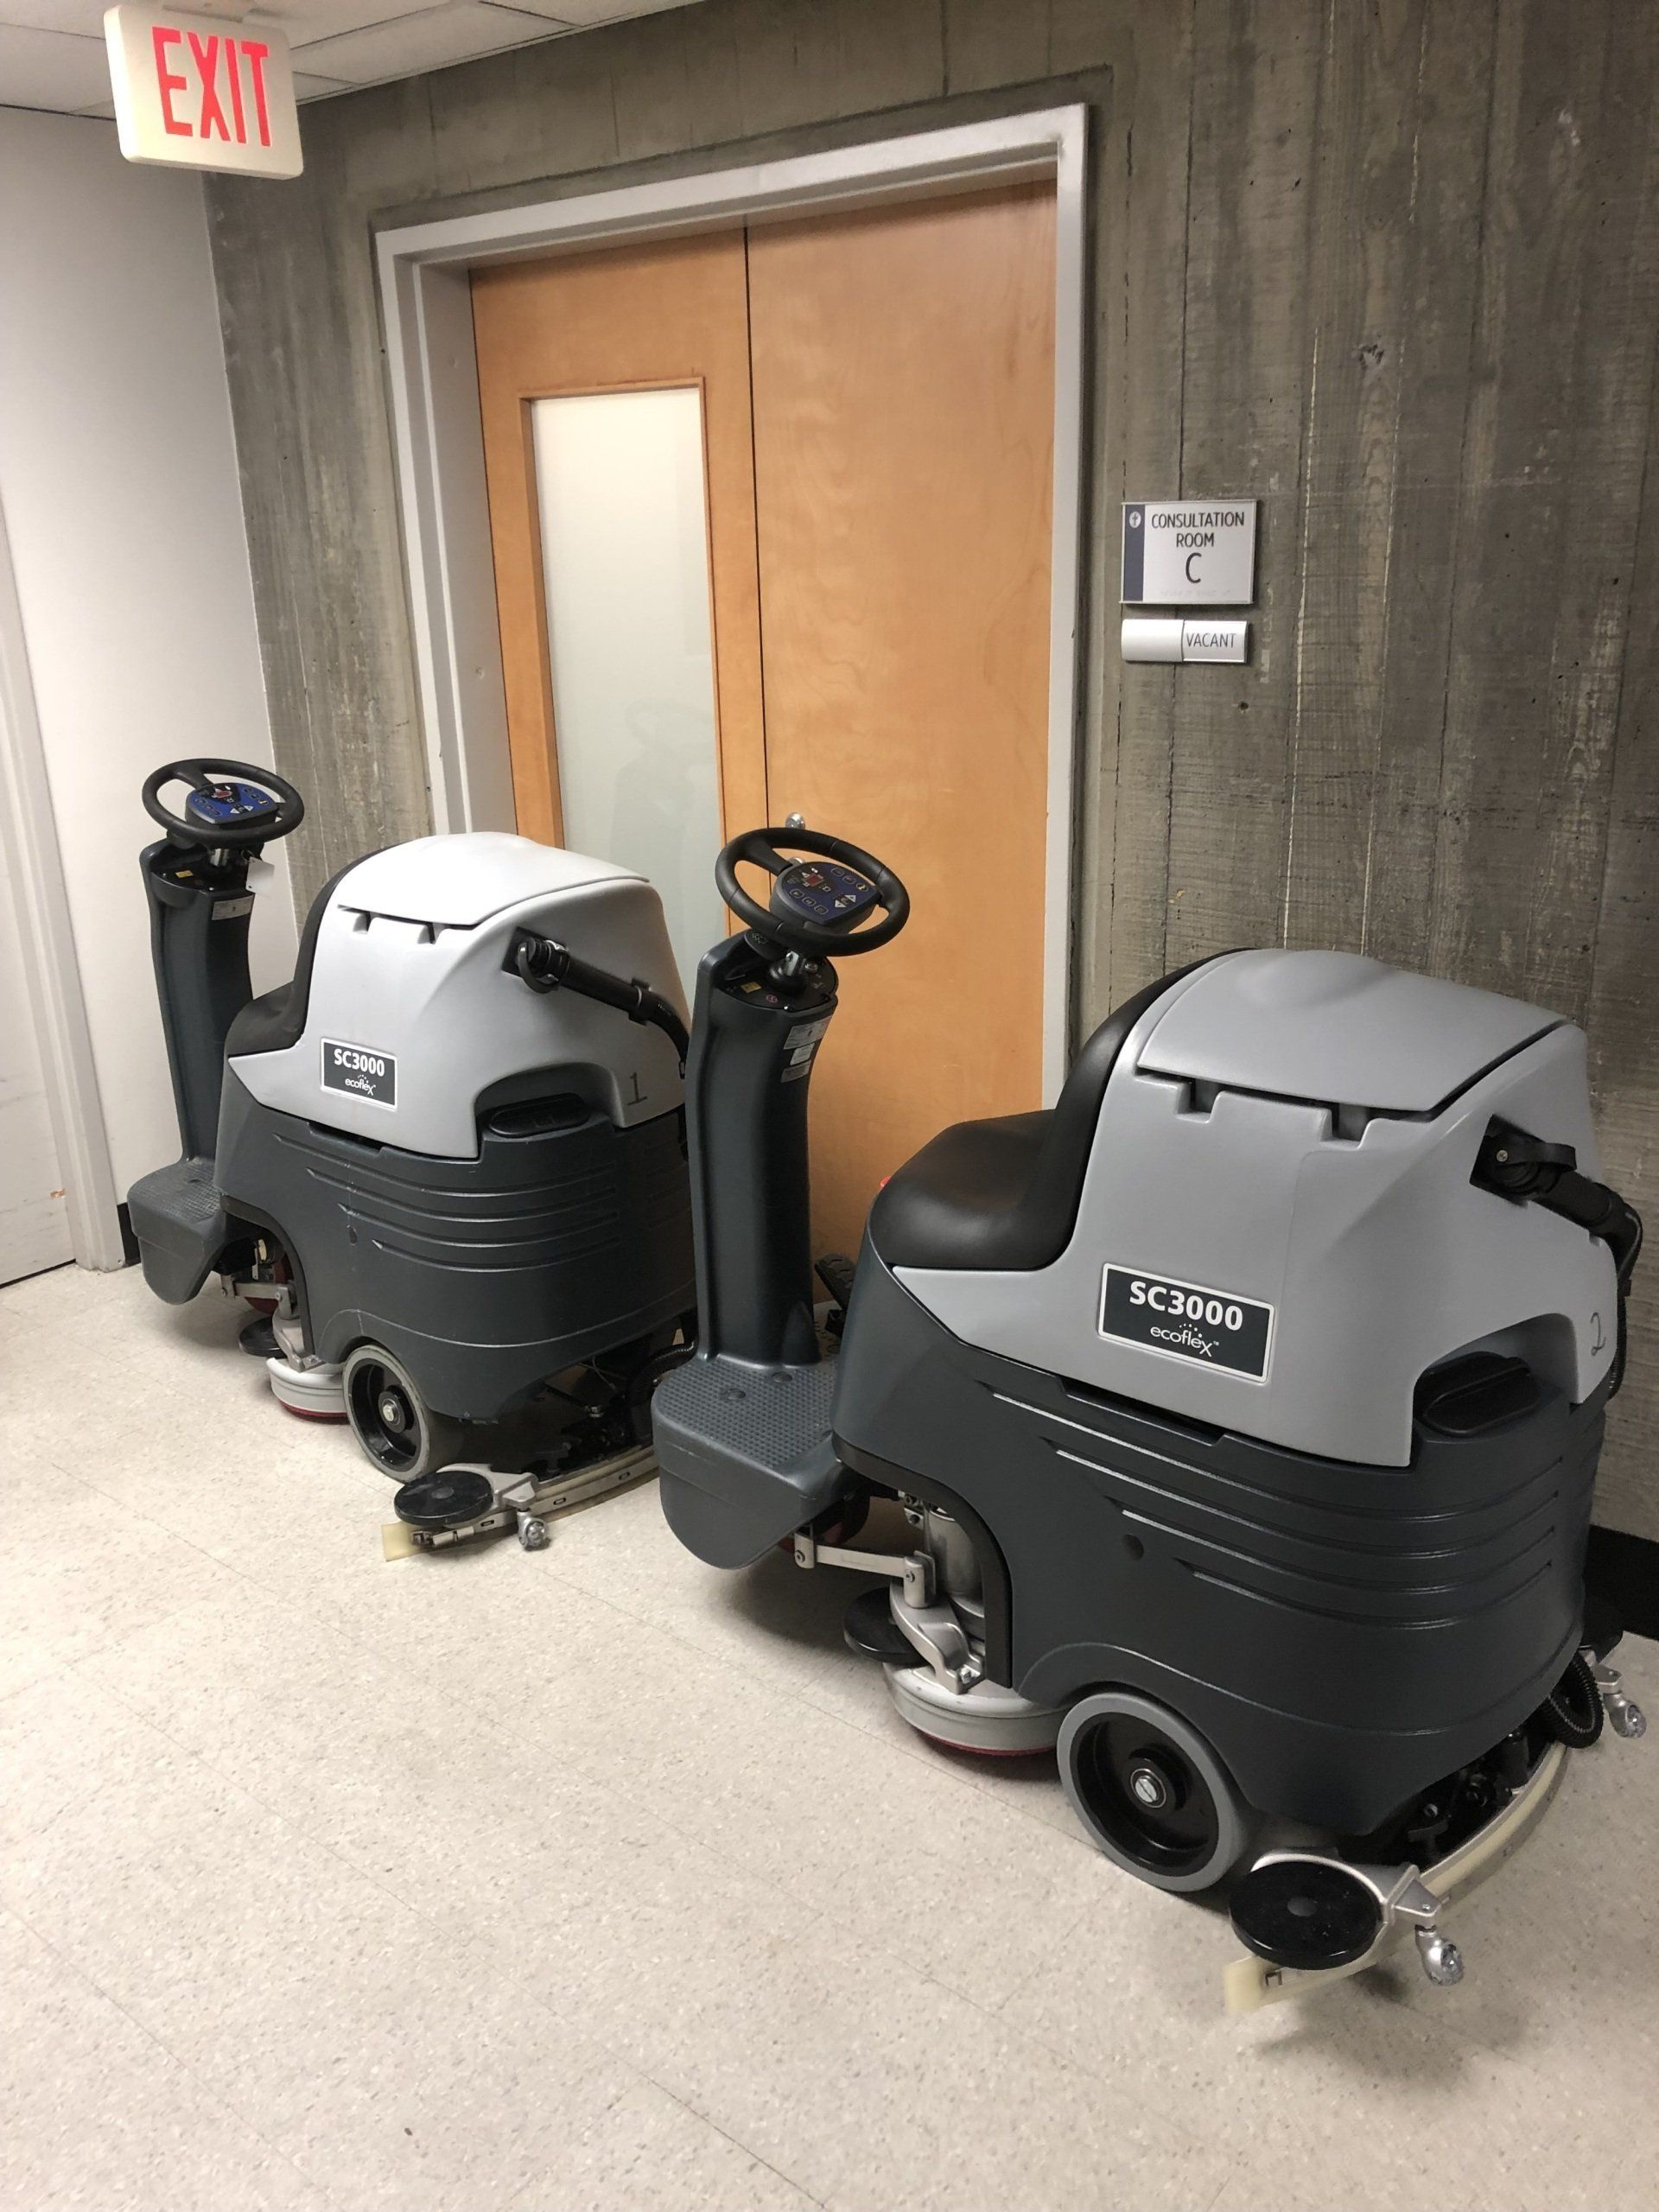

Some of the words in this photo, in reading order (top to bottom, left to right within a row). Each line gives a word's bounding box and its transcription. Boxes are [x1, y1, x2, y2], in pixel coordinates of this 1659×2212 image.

[152, 26, 271, 147] EXIT
[1151, 512, 1245, 529] CONSULTATION
[1176, 532, 1214, 548] ROOM
[1185, 552, 1202, 583] C
[1185, 632, 1236, 648] VACANT
[334, 1048, 385, 1077] SC3000
[627, 1071, 649, 1106] 1
[1128, 1281, 1243, 1332] SC3000
[1589, 1311, 1607, 1357] 2
